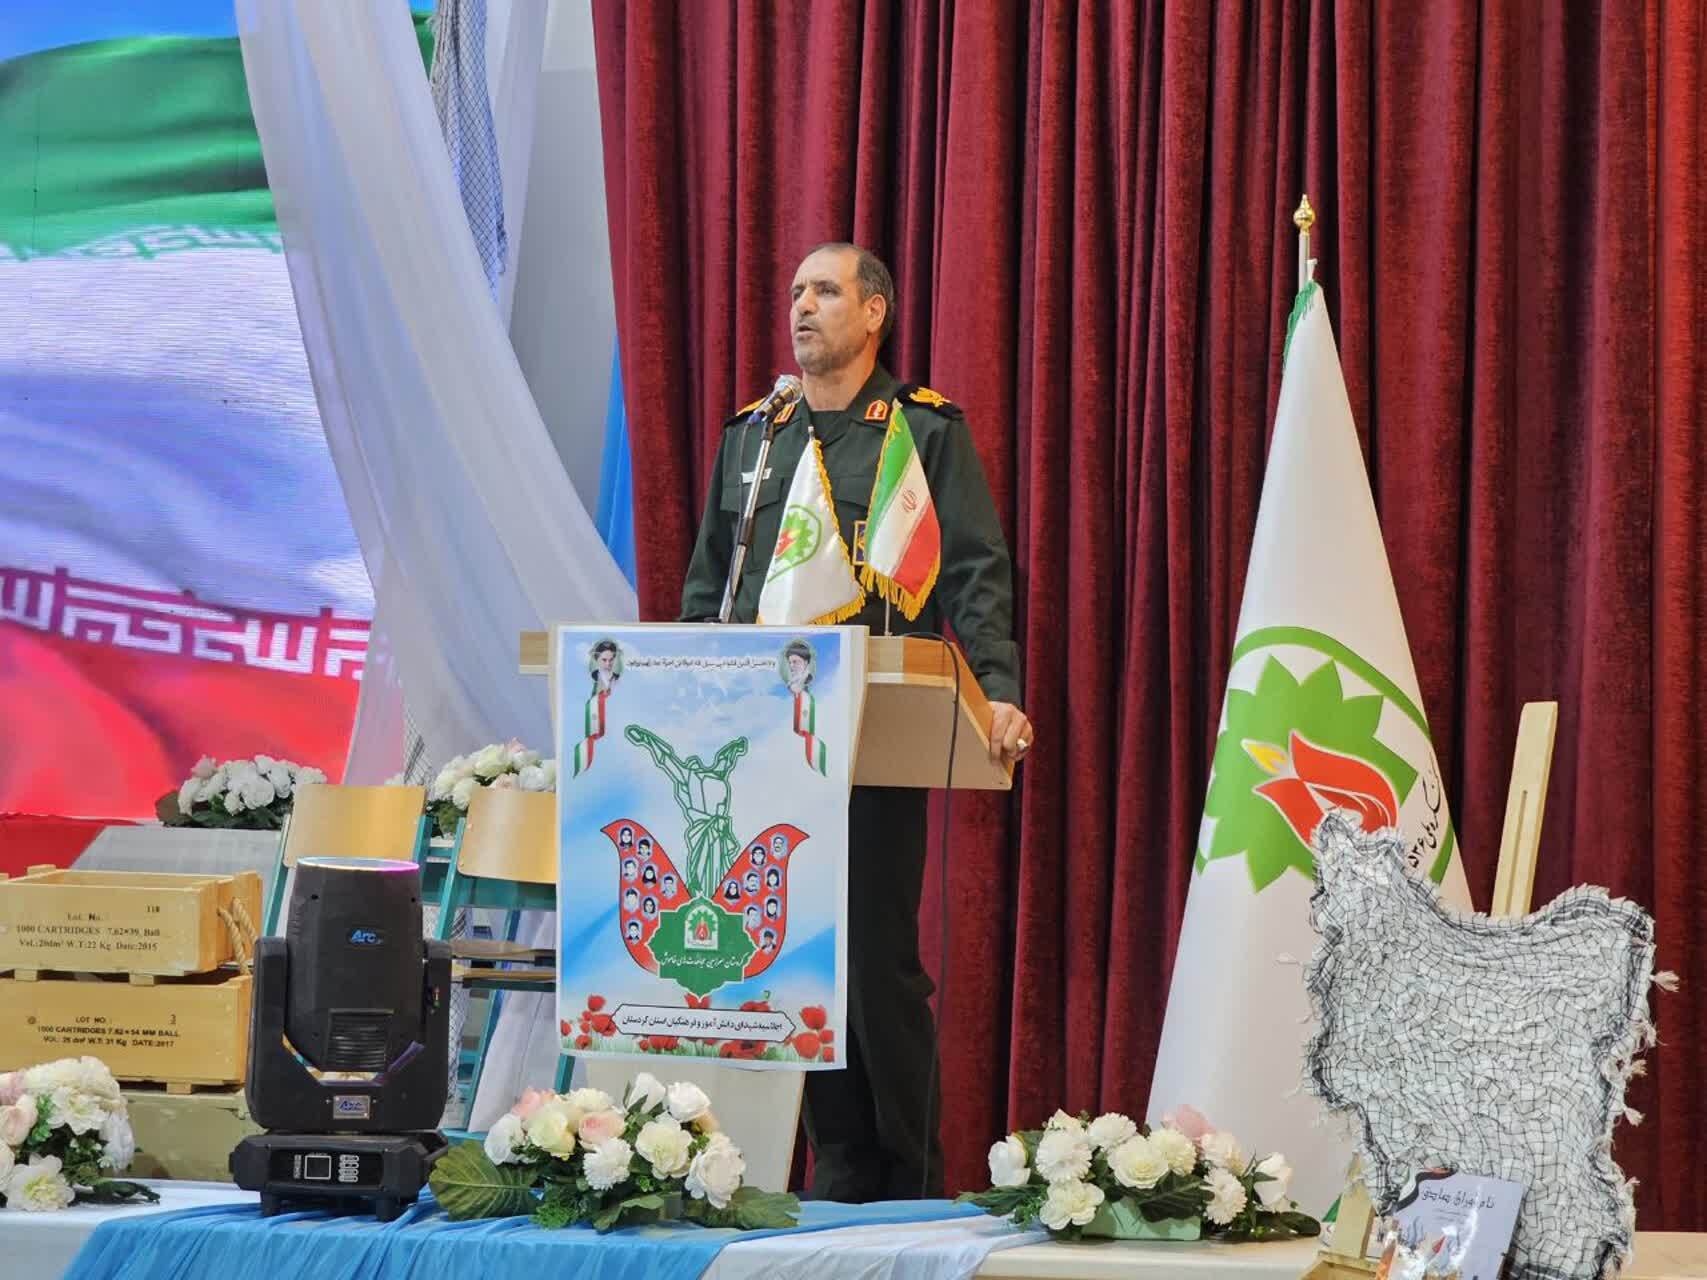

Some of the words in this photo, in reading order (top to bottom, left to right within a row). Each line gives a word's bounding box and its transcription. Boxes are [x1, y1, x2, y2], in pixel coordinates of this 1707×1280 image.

[37, 925, 101, 935] CARTRIDGES
[75, 1016, 91, 1024] LOT
[55, 1026, 107, 1035] CARTRIDGES
